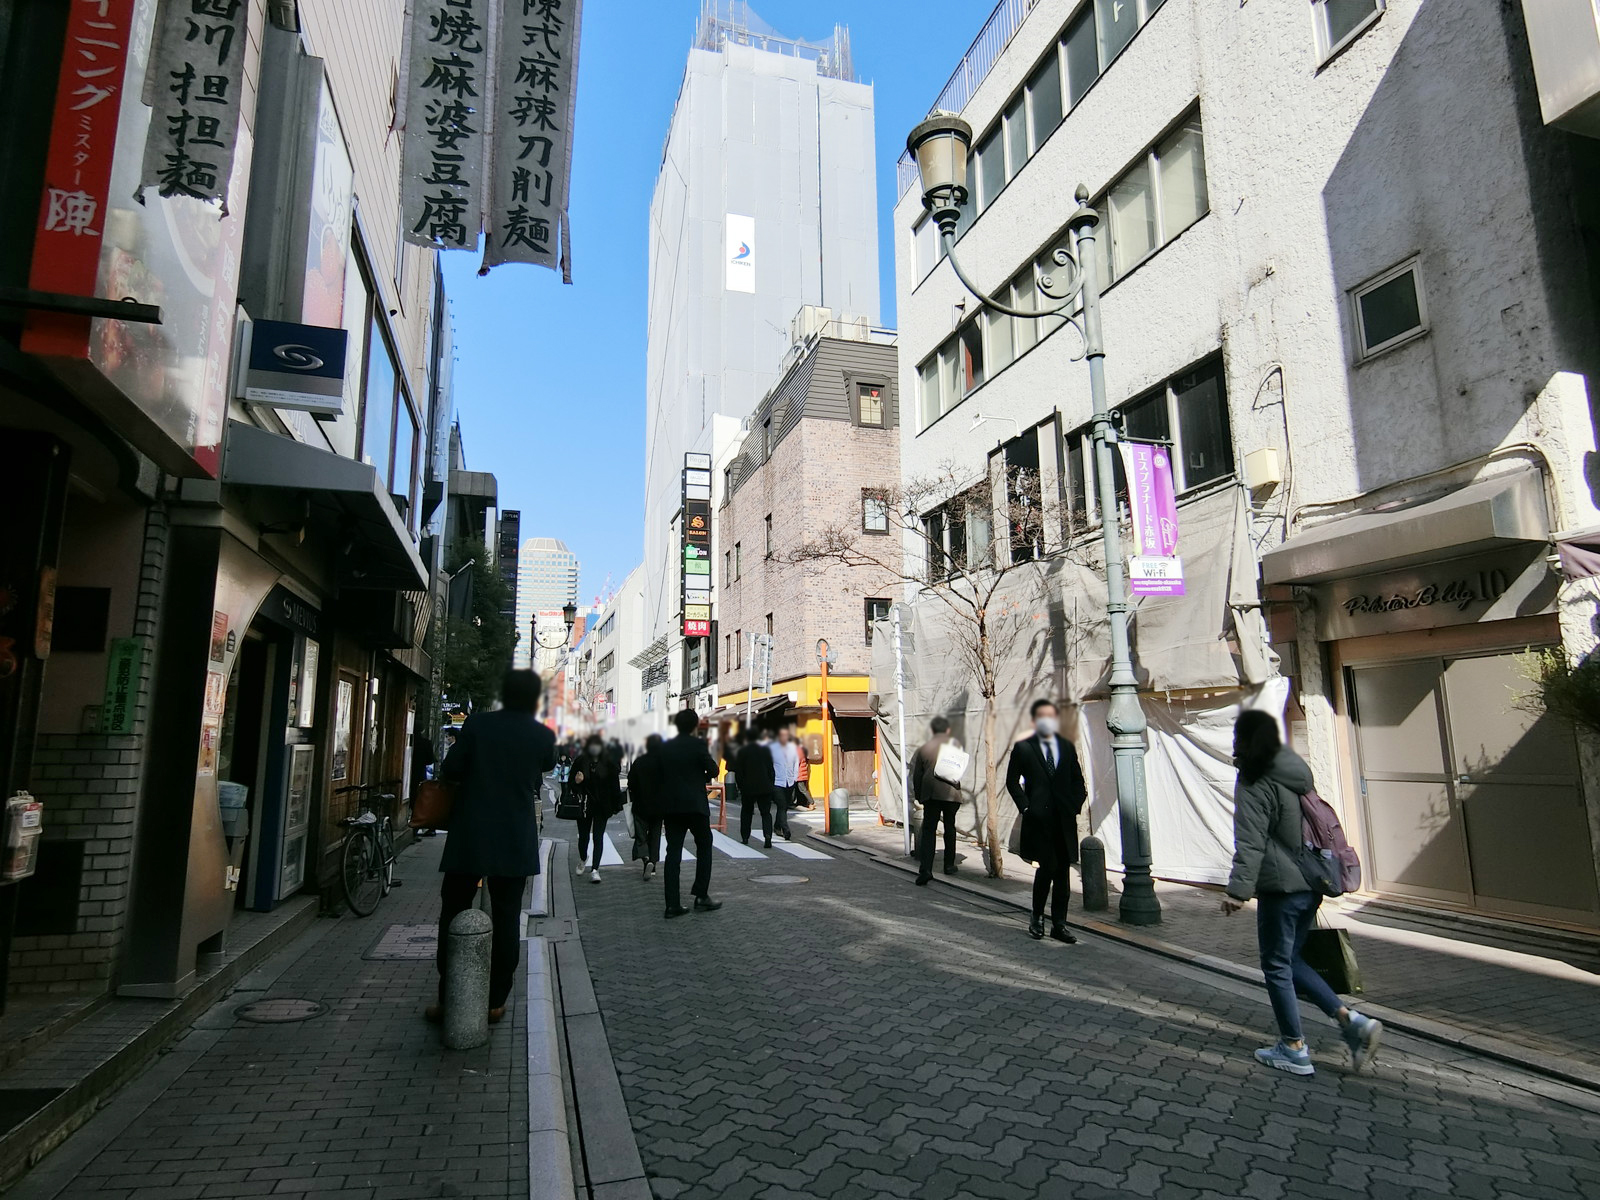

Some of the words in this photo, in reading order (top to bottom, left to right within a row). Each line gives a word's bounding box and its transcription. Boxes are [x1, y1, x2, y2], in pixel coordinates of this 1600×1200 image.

[73, 114, 93, 186] ミスター
[44, 187, 100, 236] 陳
[730, 259, 751, 267] ICHIKEN
[1137, 452, 1156, 549] エスプラナード赤坂
[1143, 569, 1167, 577] Wi-Fi
